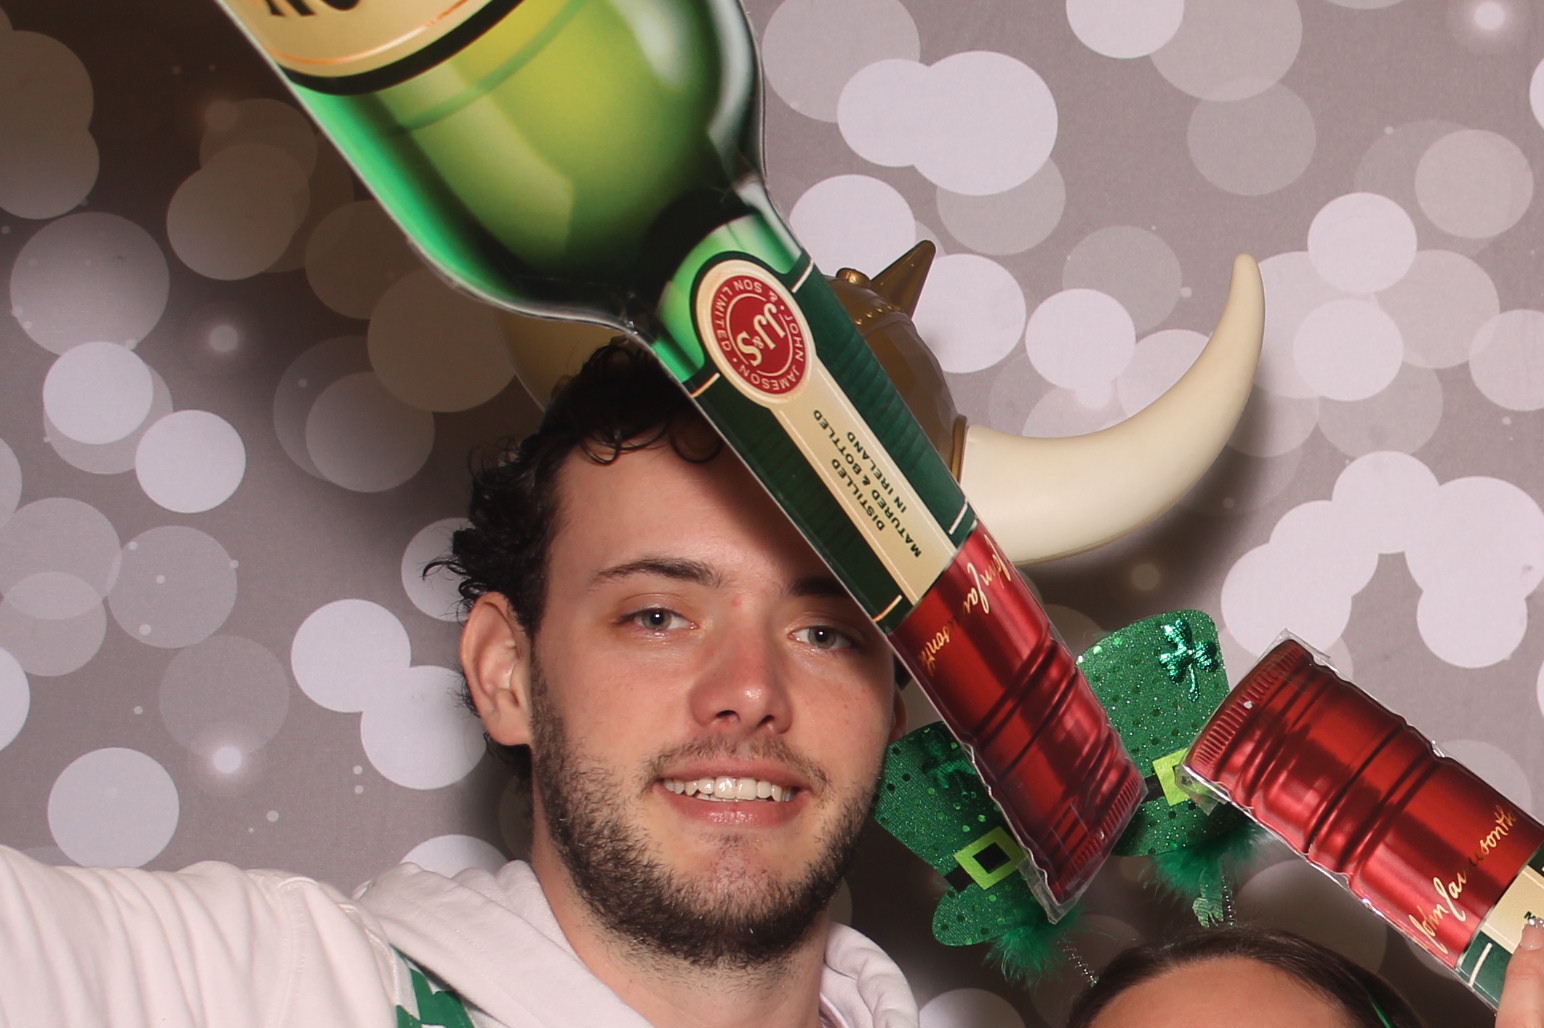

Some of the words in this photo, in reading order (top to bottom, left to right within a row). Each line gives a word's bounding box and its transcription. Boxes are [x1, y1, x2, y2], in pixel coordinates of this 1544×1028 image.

[734, 279, 762, 293] SON
[768, 292, 778, 302] &
[714, 287, 733, 351] LIMITED
[737, 303, 786, 367] JJ&S
[784, 314, 804, 362] JOHN
[739, 364, 800, 391] JAMESON
[813, 410, 863, 476] BOTTLED
[847, 432, 893, 495] IRELAND
[831, 459, 885, 531] DISTILLED
[862, 475, 871, 486] &
[893, 496, 907, 513] IN
[871, 490, 922, 557] MATURED
